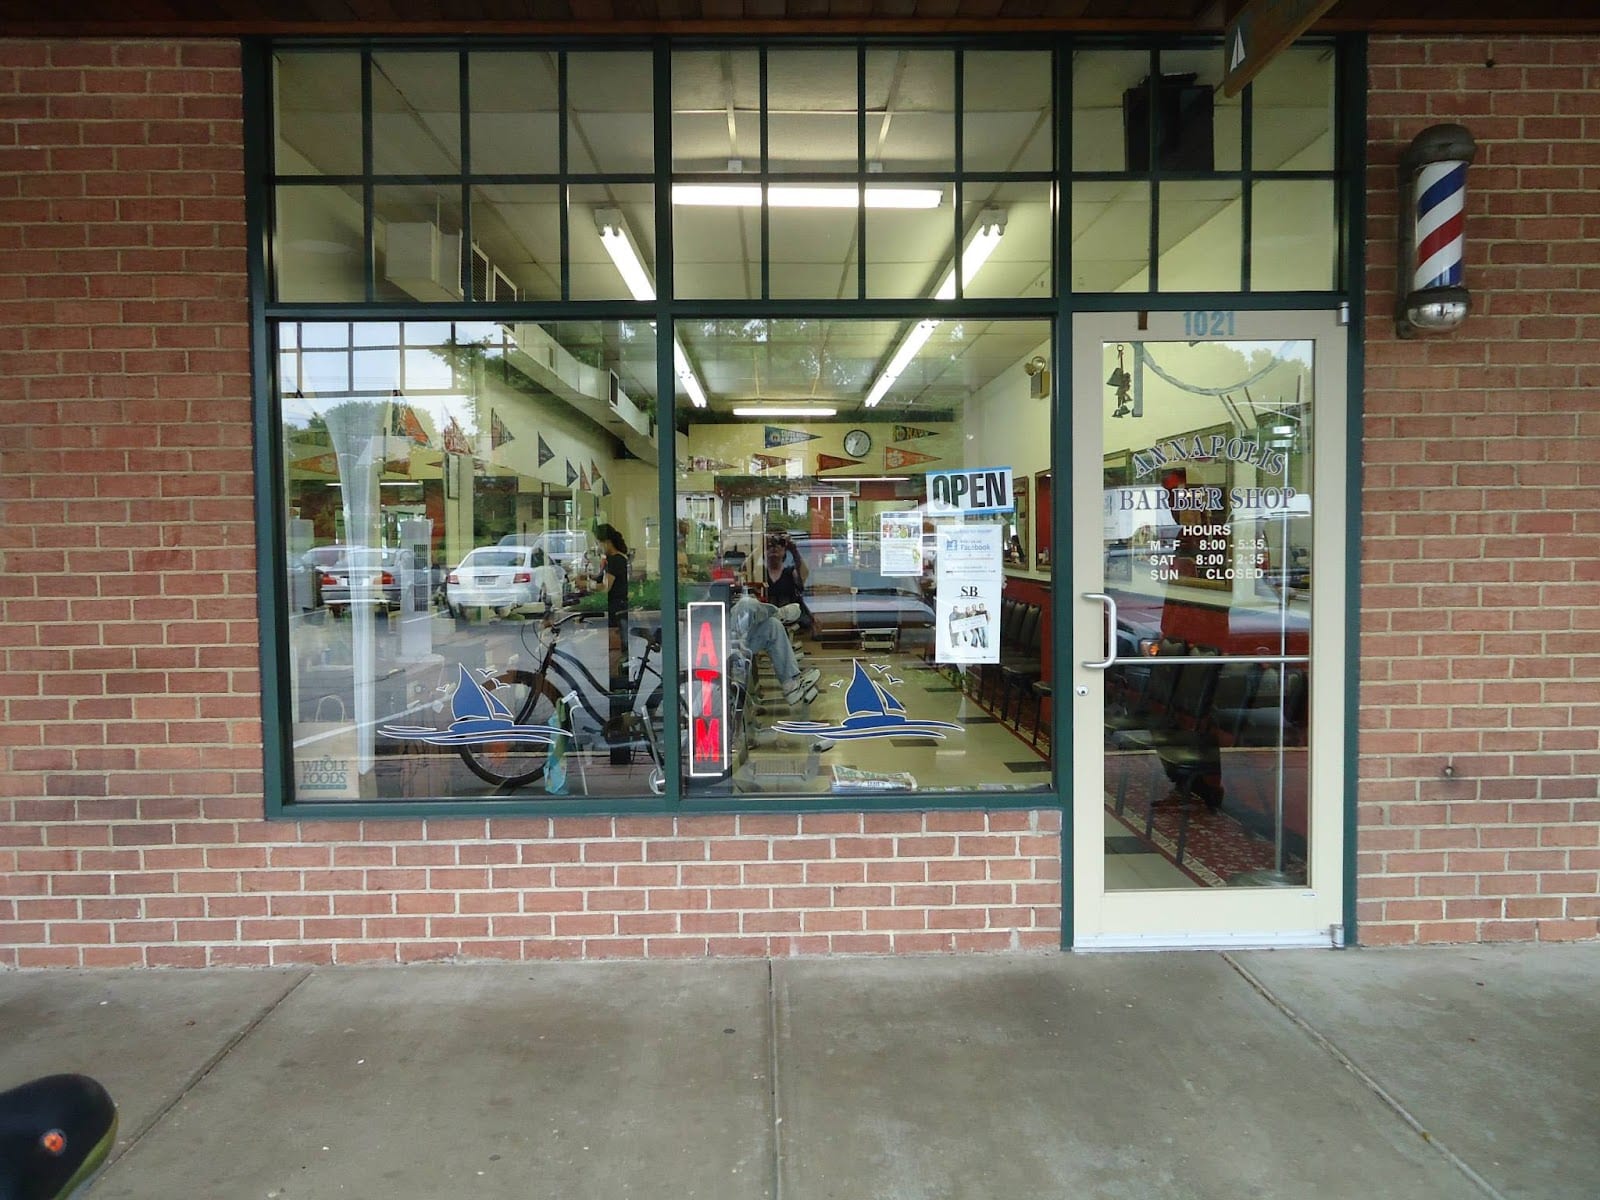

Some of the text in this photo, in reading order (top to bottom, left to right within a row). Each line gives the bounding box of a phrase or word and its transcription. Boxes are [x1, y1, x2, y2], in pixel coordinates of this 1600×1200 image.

[1183, 311, 1235, 336] 1021
[1132, 434, 1285, 479] ANNAPOLIS
[932, 472, 1007, 511] OPEN
[1119, 486, 1297, 512] BARBER SHOP
[1183, 525, 1231, 536] HOURS
[1150, 540, 1161, 551] M
[1172, 540, 1181, 551] F
[1199, 539, 1226, 551] 8:00
[1150, 555, 1176, 566] SAT
[1196, 554, 1224, 565] 8:00
[1150, 568, 1264, 580] SUN CLOSED
[695, 621, 720, 763] ATM
[302, 760, 348, 772] WHOLE
[303, 772, 346, 784] FOODS
